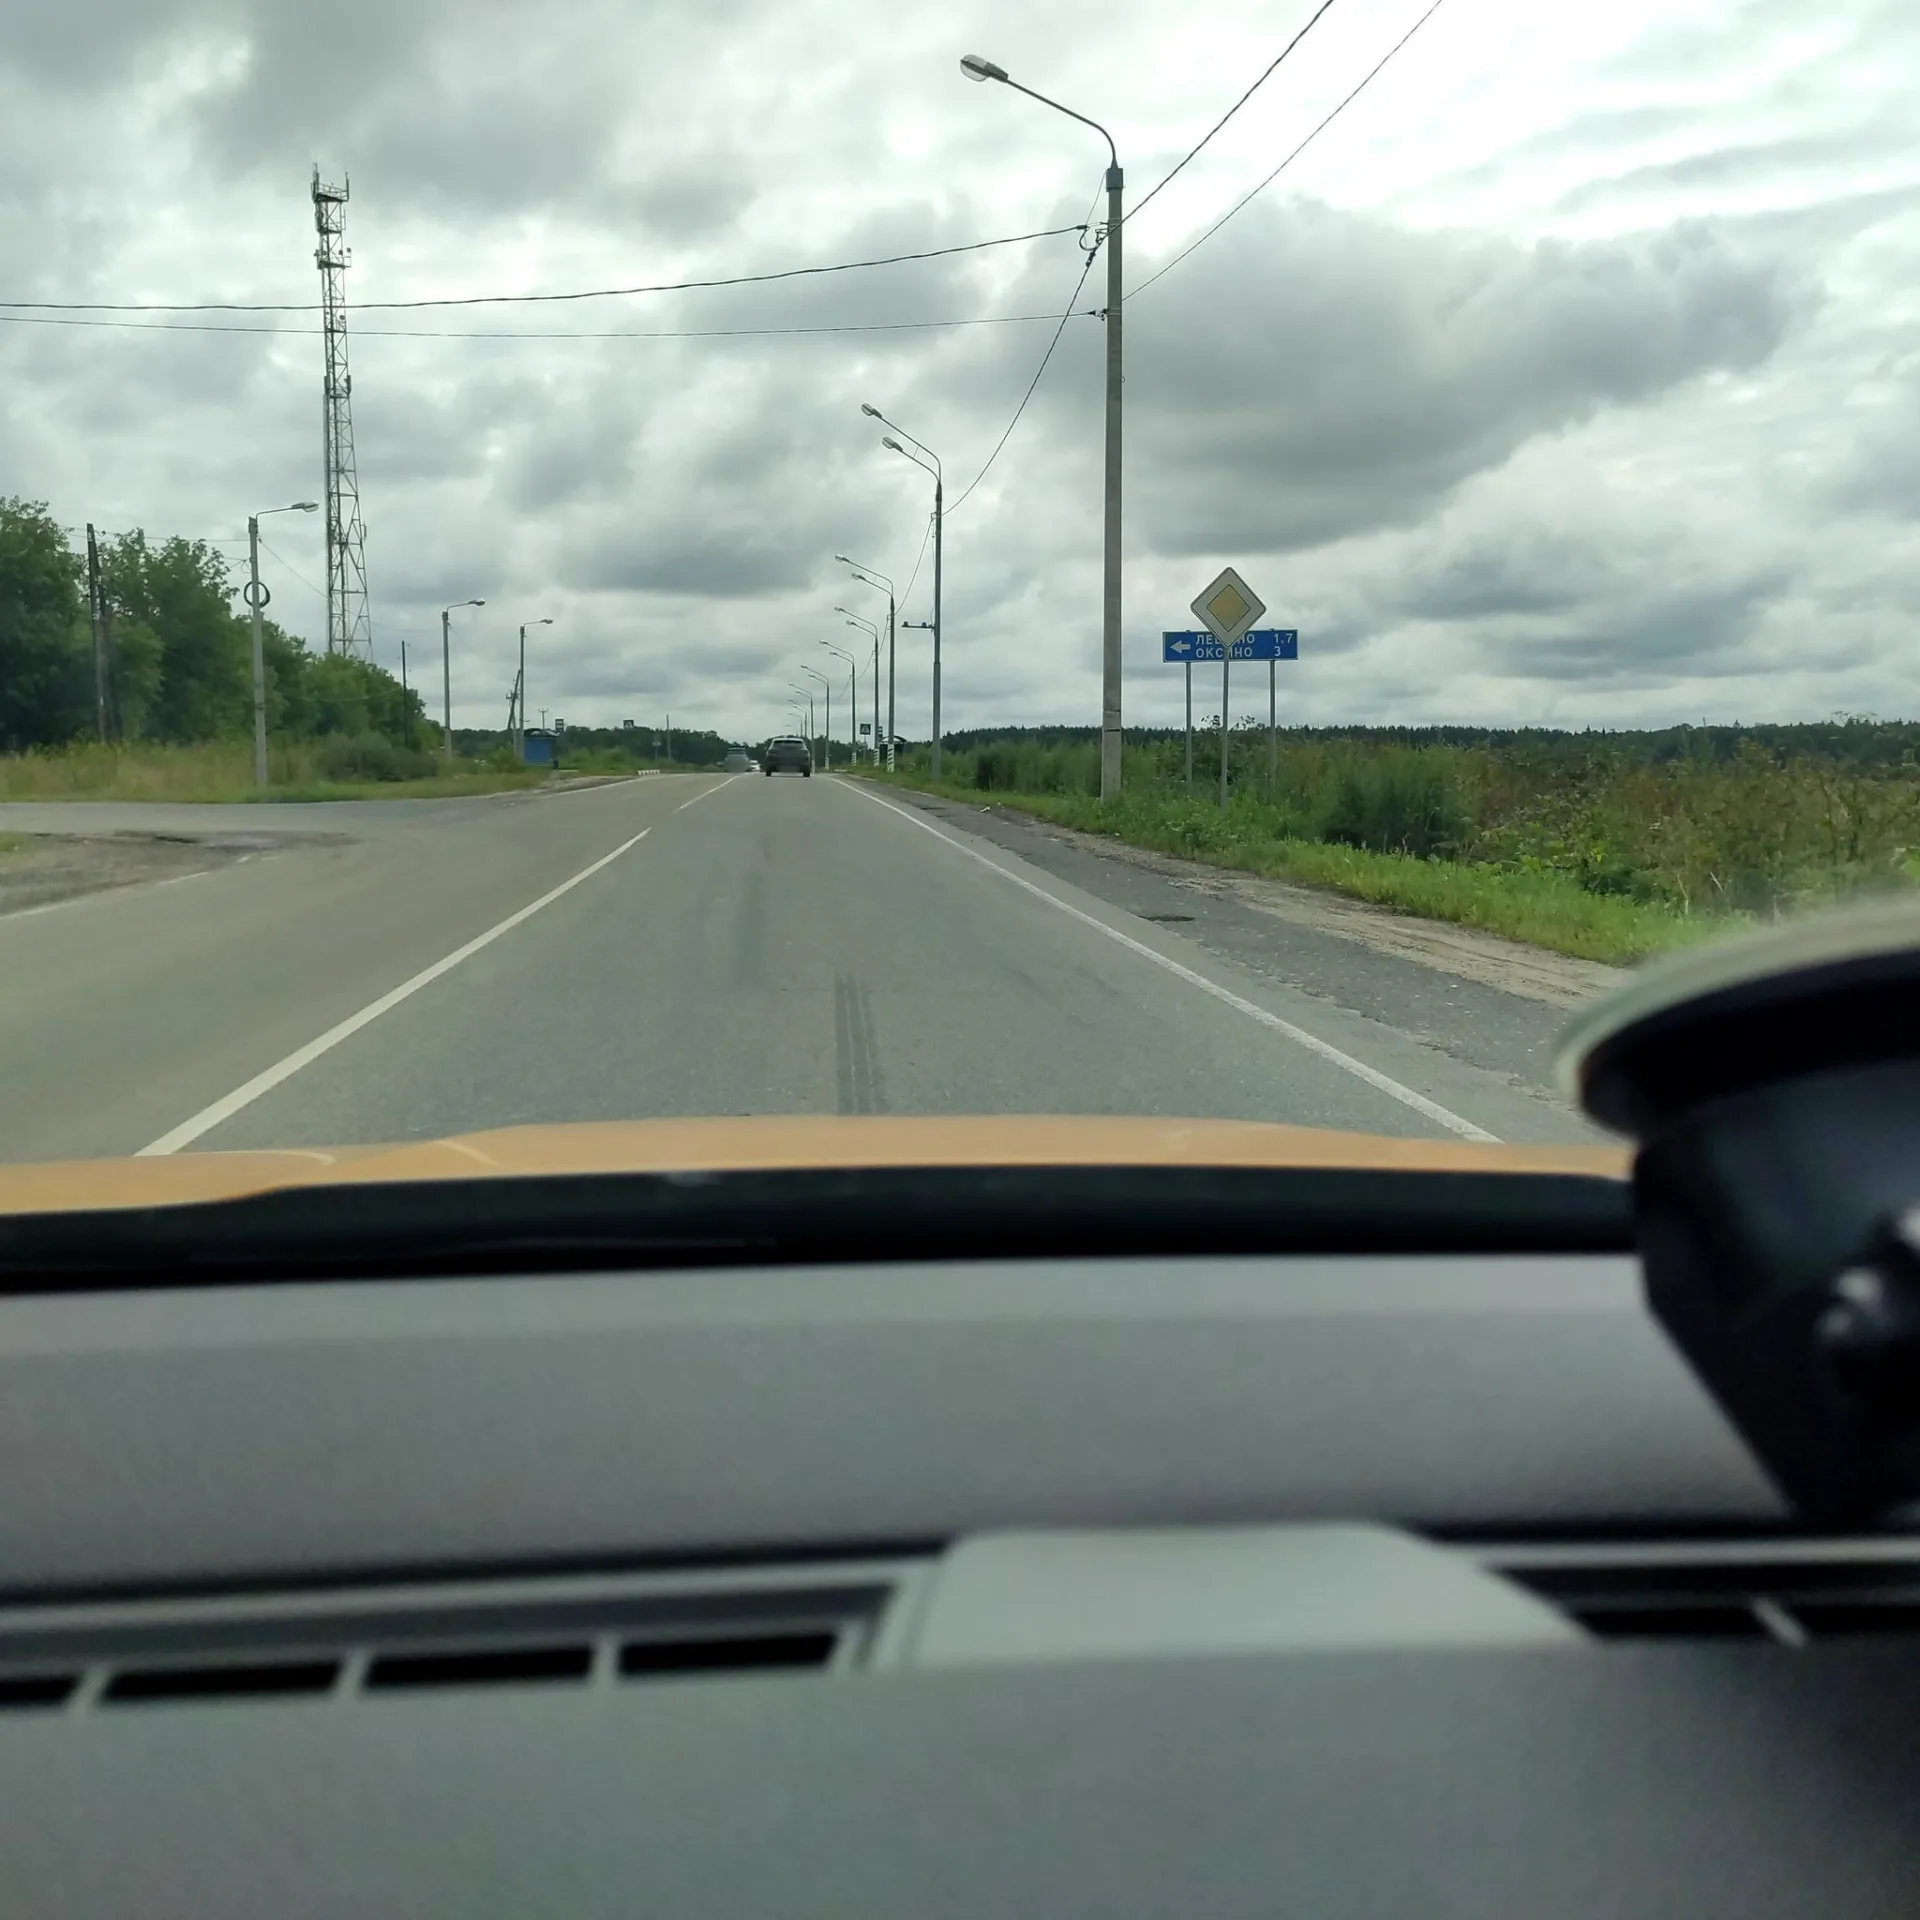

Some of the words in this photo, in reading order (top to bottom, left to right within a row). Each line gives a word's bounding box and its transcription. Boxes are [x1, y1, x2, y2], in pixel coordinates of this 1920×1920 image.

[1195, 633, 1255, 645] ЛЕНО
[1273, 632, 1293, 644] 1.7
[1273, 645, 1281, 657] 3
